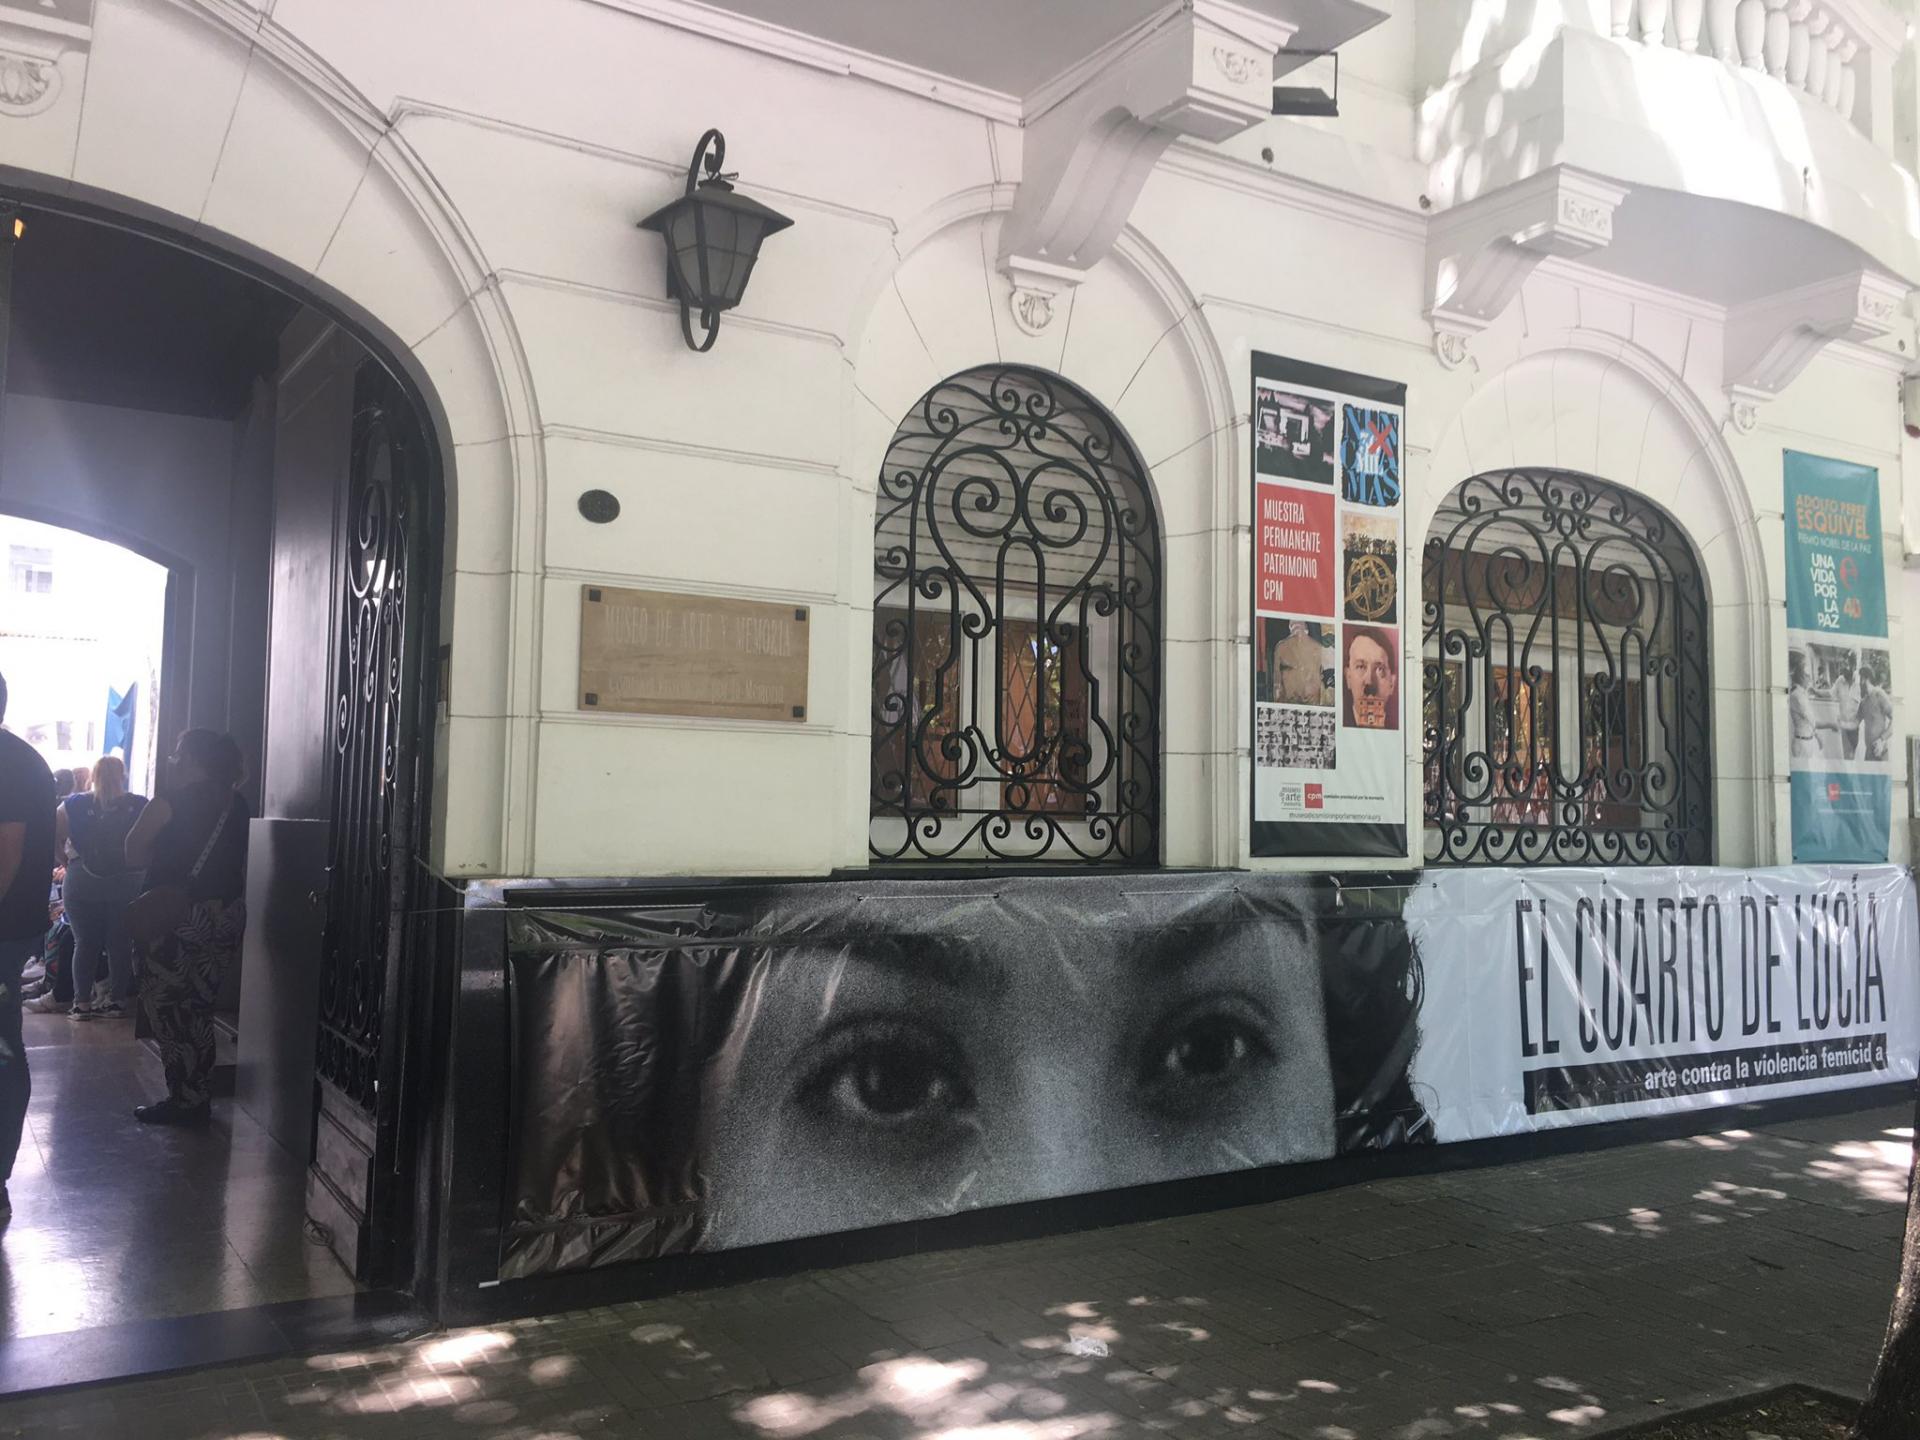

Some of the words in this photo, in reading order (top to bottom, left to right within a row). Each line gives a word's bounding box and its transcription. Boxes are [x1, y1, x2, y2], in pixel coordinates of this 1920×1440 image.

[1263, 498, 1305, 525] MUESTRA
[1797, 509, 1871, 540] ESQUIVEL
[1263, 525, 1321, 553] PERMANENTE
[1263, 552, 1318, 579] PATRIMONIO
[1811, 552, 1835, 570] UNA
[1810, 567, 1837, 584] VIDA
[1263, 578, 1284, 602] CPM
[1814, 583, 1838, 599] POR
[1824, 598, 1839, 614] LA
[605, 604, 648, 646] MUSEO
[655, 608, 673, 648] DE
[680, 611, 713, 650] ARTE
[736, 616, 793, 657] MEMORIA
[1818, 611, 1840, 628] PAZ
[1307, 792, 1322, 801] cpm
[1515, 898, 1560, 1058] EL
[1574, 893, 1724, 1054] CUARTO
[1739, 895, 1782, 1037] DE
[1795, 873, 1887, 1031] LUCÍA
[1644, 1068, 1677, 1090] arte
[1681, 1062, 1732, 1086] contra
[1735, 1056, 1750, 1079] la
[1753, 1049, 1818, 1077] violencia
